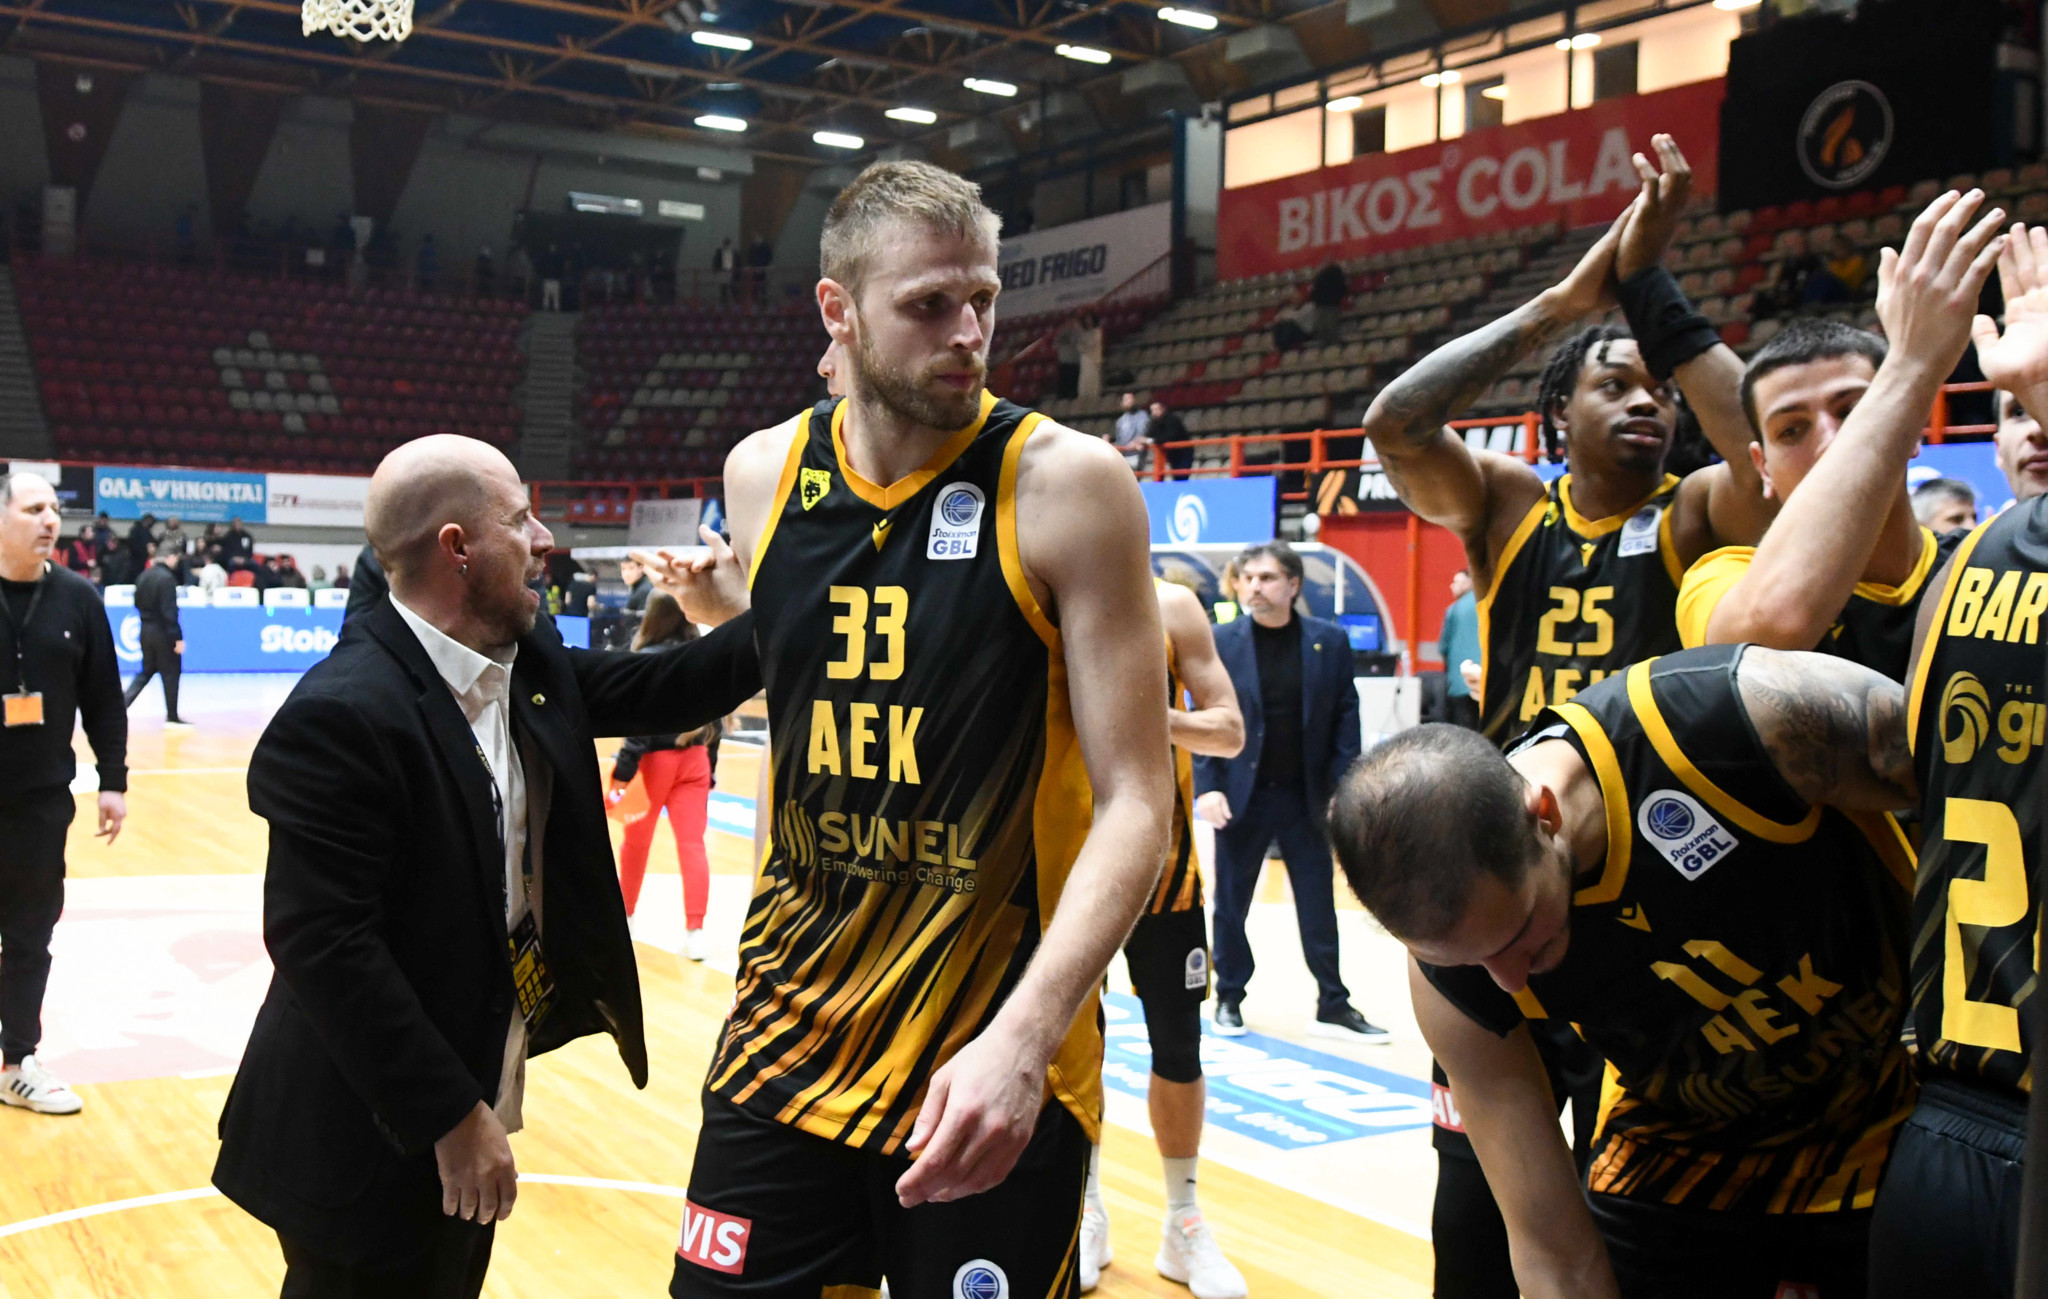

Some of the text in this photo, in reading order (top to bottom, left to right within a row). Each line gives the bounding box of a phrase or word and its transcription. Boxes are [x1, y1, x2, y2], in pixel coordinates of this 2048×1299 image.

[1277, 126, 1639, 255] ΒΙΚΟΣ COLA
[1039, 243, 1107, 285] FRIGO
[932, 528, 977, 538] Stoiximan
[933, 539, 972, 555] GBL
[827, 585, 909, 681] 33
[1536, 586, 1614, 656] 25
[2005, 683, 2033, 695] THE
[807, 699, 925, 785] AEK
[818, 811, 977, 871] SUNEL
[1670, 824, 1719, 862] Stoiximan
[1682, 837, 1732, 872] GBL
[821, 857, 975, 894] Empowering Change
[1941, 796, 2042, 1054] 2
[1650, 939, 1765, 1012] 11
[1701, 952, 1845, 1055] AEK
[679, 1206, 746, 1266] VIS
